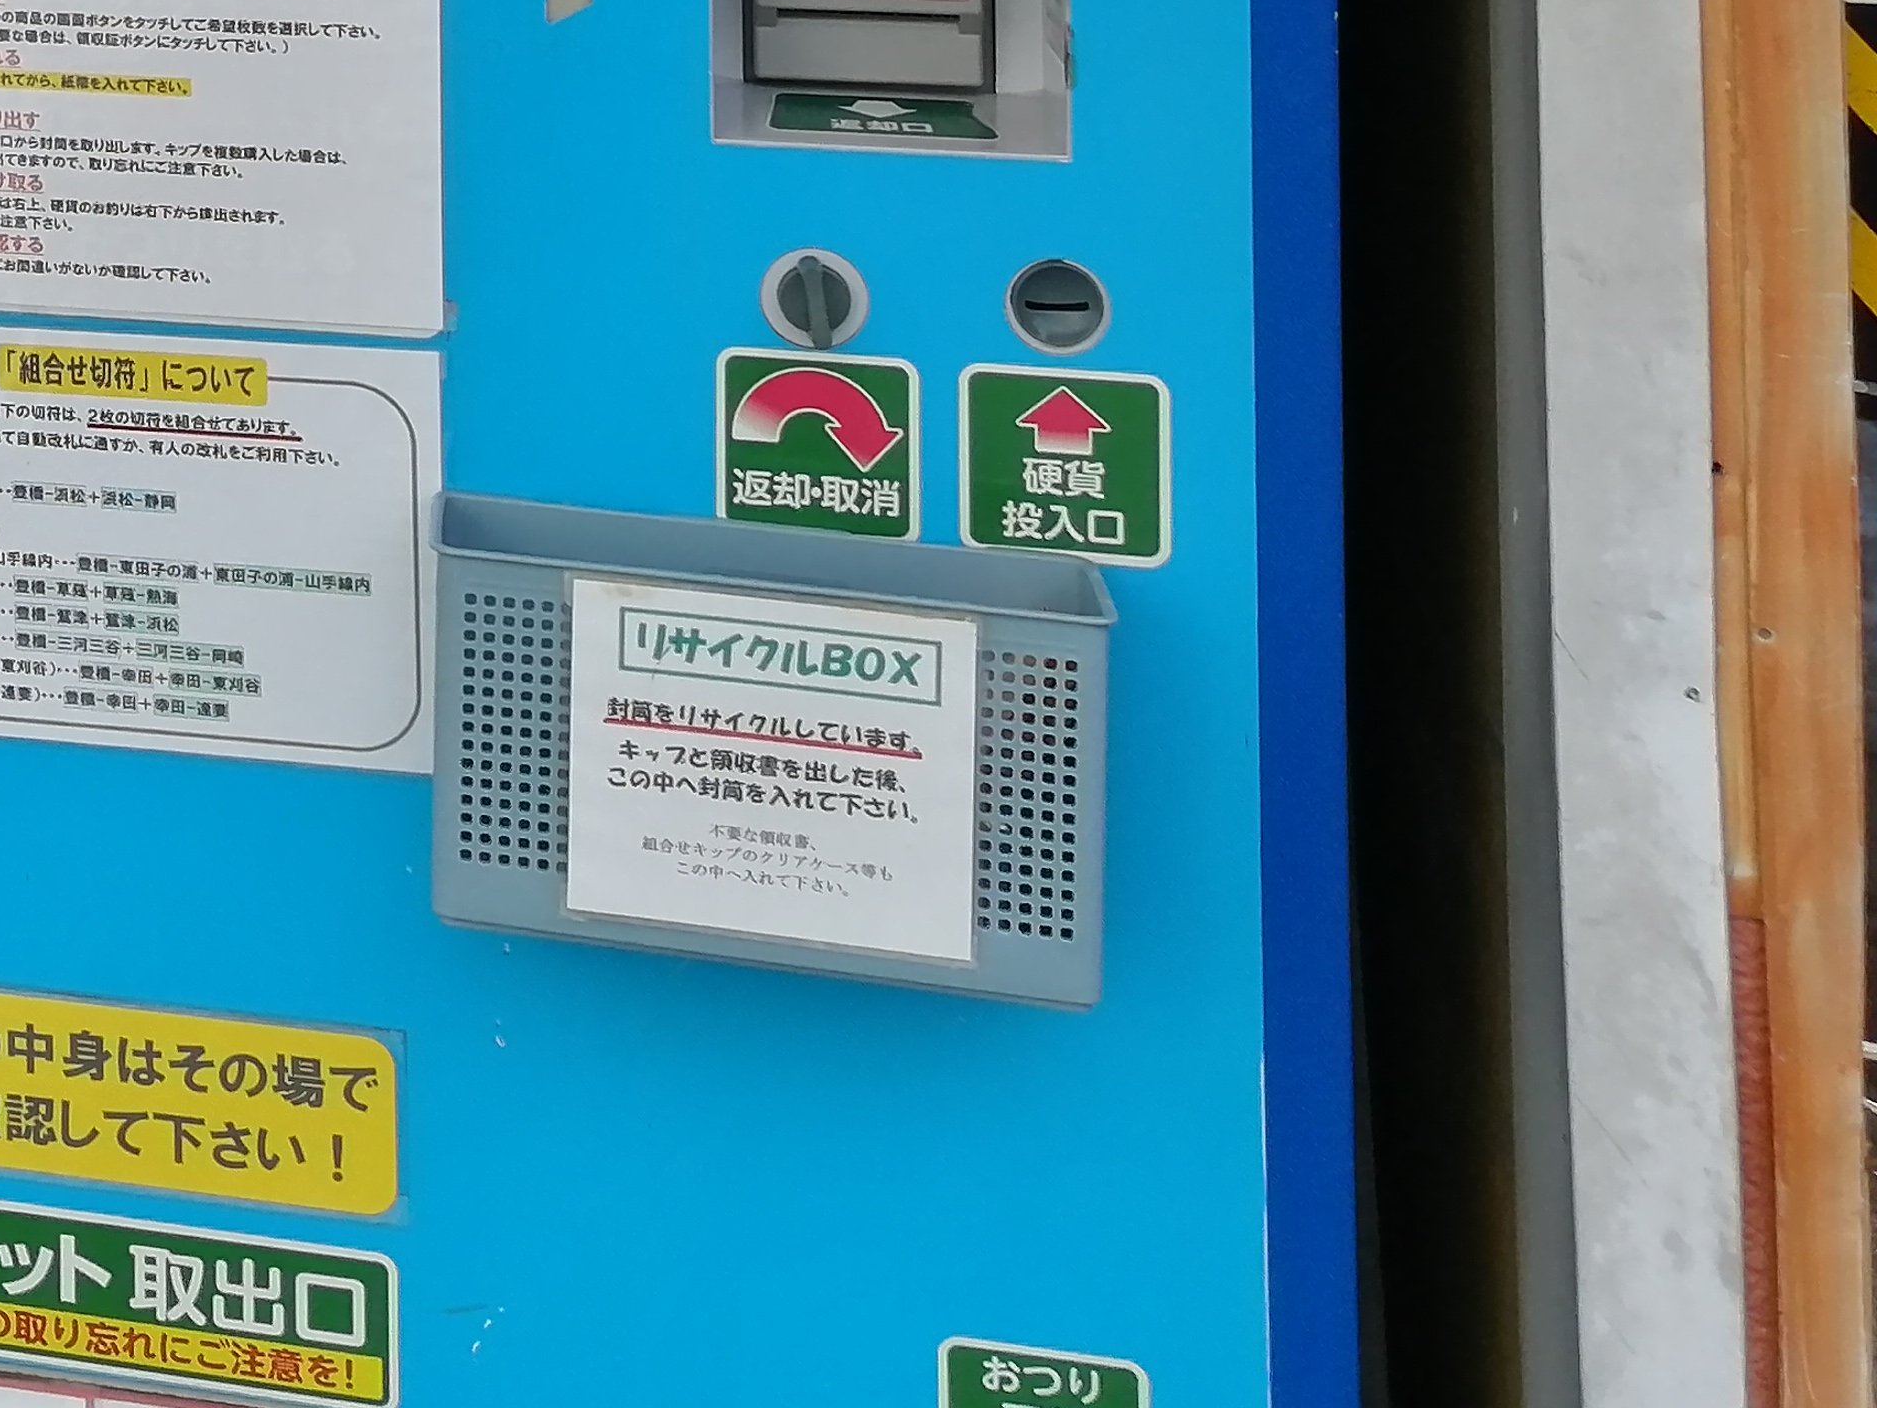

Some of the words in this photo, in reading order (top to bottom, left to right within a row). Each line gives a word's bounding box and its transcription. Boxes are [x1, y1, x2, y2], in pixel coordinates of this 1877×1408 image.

[3, 348, 257, 399] 「組合せ切符」について
[731, 467, 902, 519] 返却・取消
[1021, 457, 1105, 502] 硬貨
[1000, 505, 1126, 548] 投入口
[635, 620, 924, 688] リサイクルBOX
[606, 697, 923, 757] 封筒をリサイクルしています。
[617, 738, 907, 795] キップと領収書を出した後、
[606, 765, 920, 826] この中へ封筒を入れて下さい。
[128, 1244, 365, 1345] 取出口
[982, 1355, 1101, 1406] おつり
